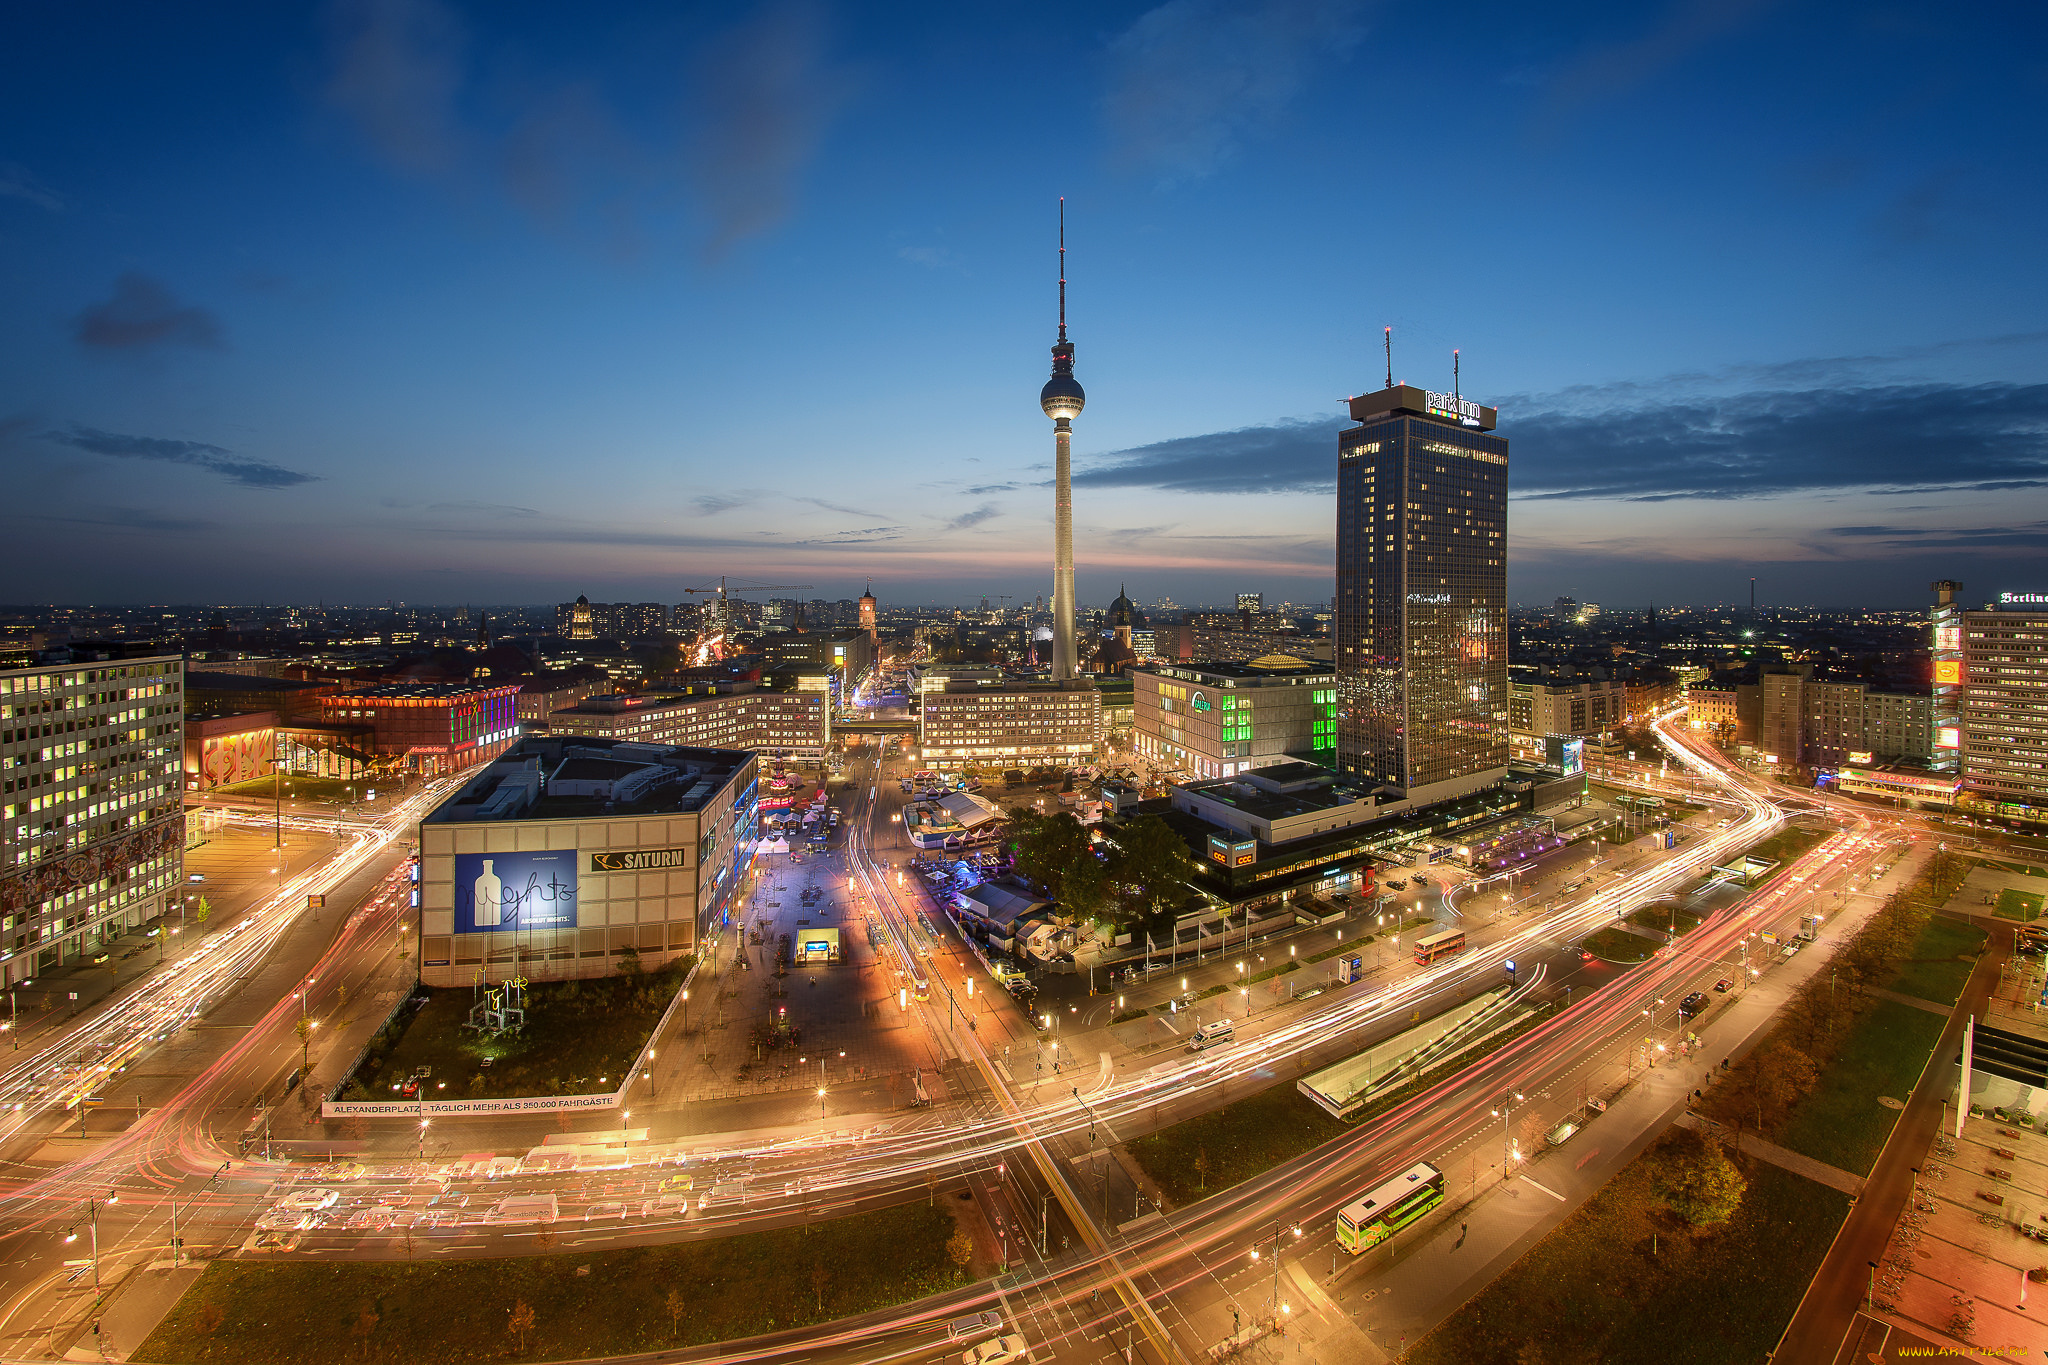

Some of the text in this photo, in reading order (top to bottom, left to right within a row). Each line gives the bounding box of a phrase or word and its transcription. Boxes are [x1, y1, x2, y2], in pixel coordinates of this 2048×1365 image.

[1425, 390, 1480, 418] park inn
[458, 701, 482, 720] ALEXA
[1195, 699, 1211, 712] GALERIA
[1870, 772, 1930, 785] ESCADOS
[624, 850, 683, 869] SATURN
[1213, 852, 1226, 863] CCC
[1238, 855, 1252, 865] CCC
[334, 1105, 420, 1113] ALEXANDERPLATZ
[430, 1104, 470, 1112] TÄGLICH
[472, 1103, 501, 1111] MEHR
[503, 1102, 521, 1110] ALS
[523, 1101, 557, 1109] 350.000
[558, 1097, 613, 1107] FAHRGÄSTE
